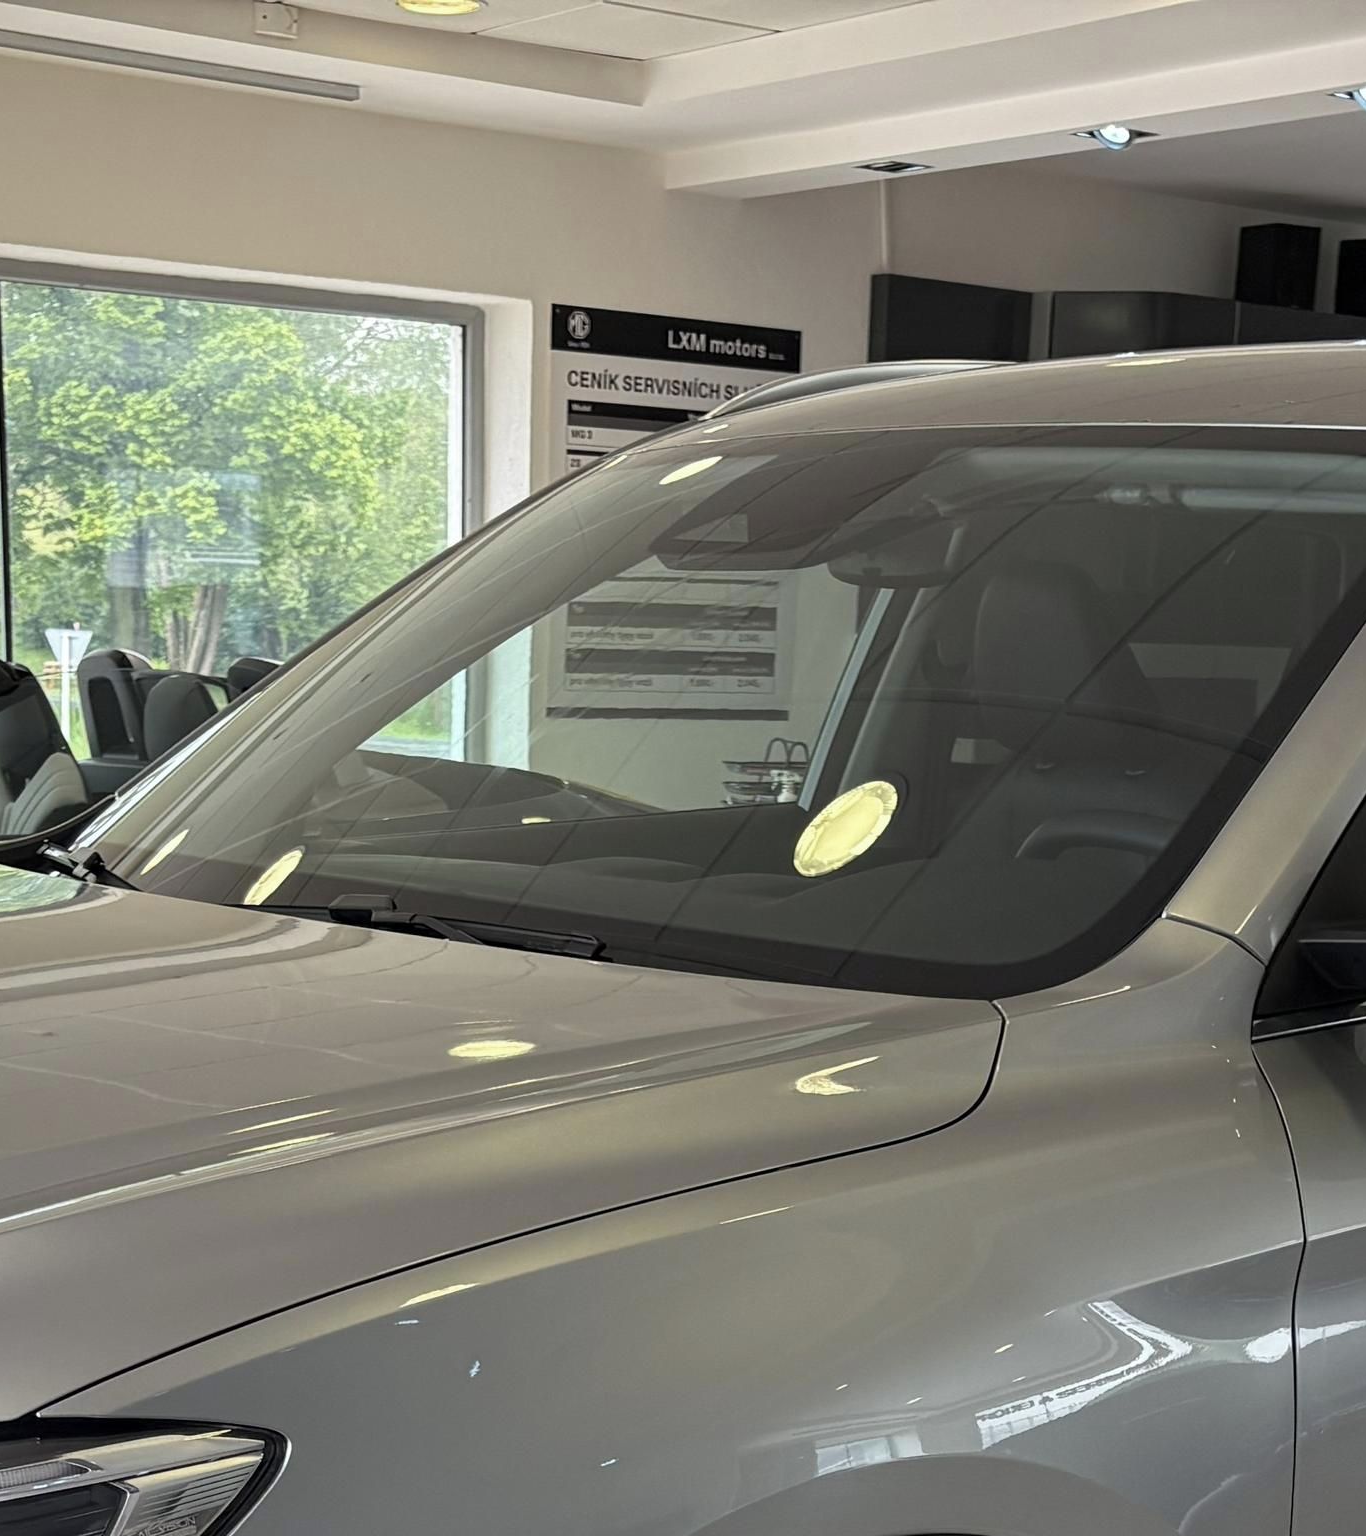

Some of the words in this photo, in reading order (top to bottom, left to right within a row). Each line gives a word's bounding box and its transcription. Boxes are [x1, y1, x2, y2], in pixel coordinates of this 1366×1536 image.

[667, 330, 706, 352] LXM
[710, 338, 767, 358] motors
[567, 369, 619, 391] CENÍK
[622, 375, 720, 399] SERVISNÍCH
